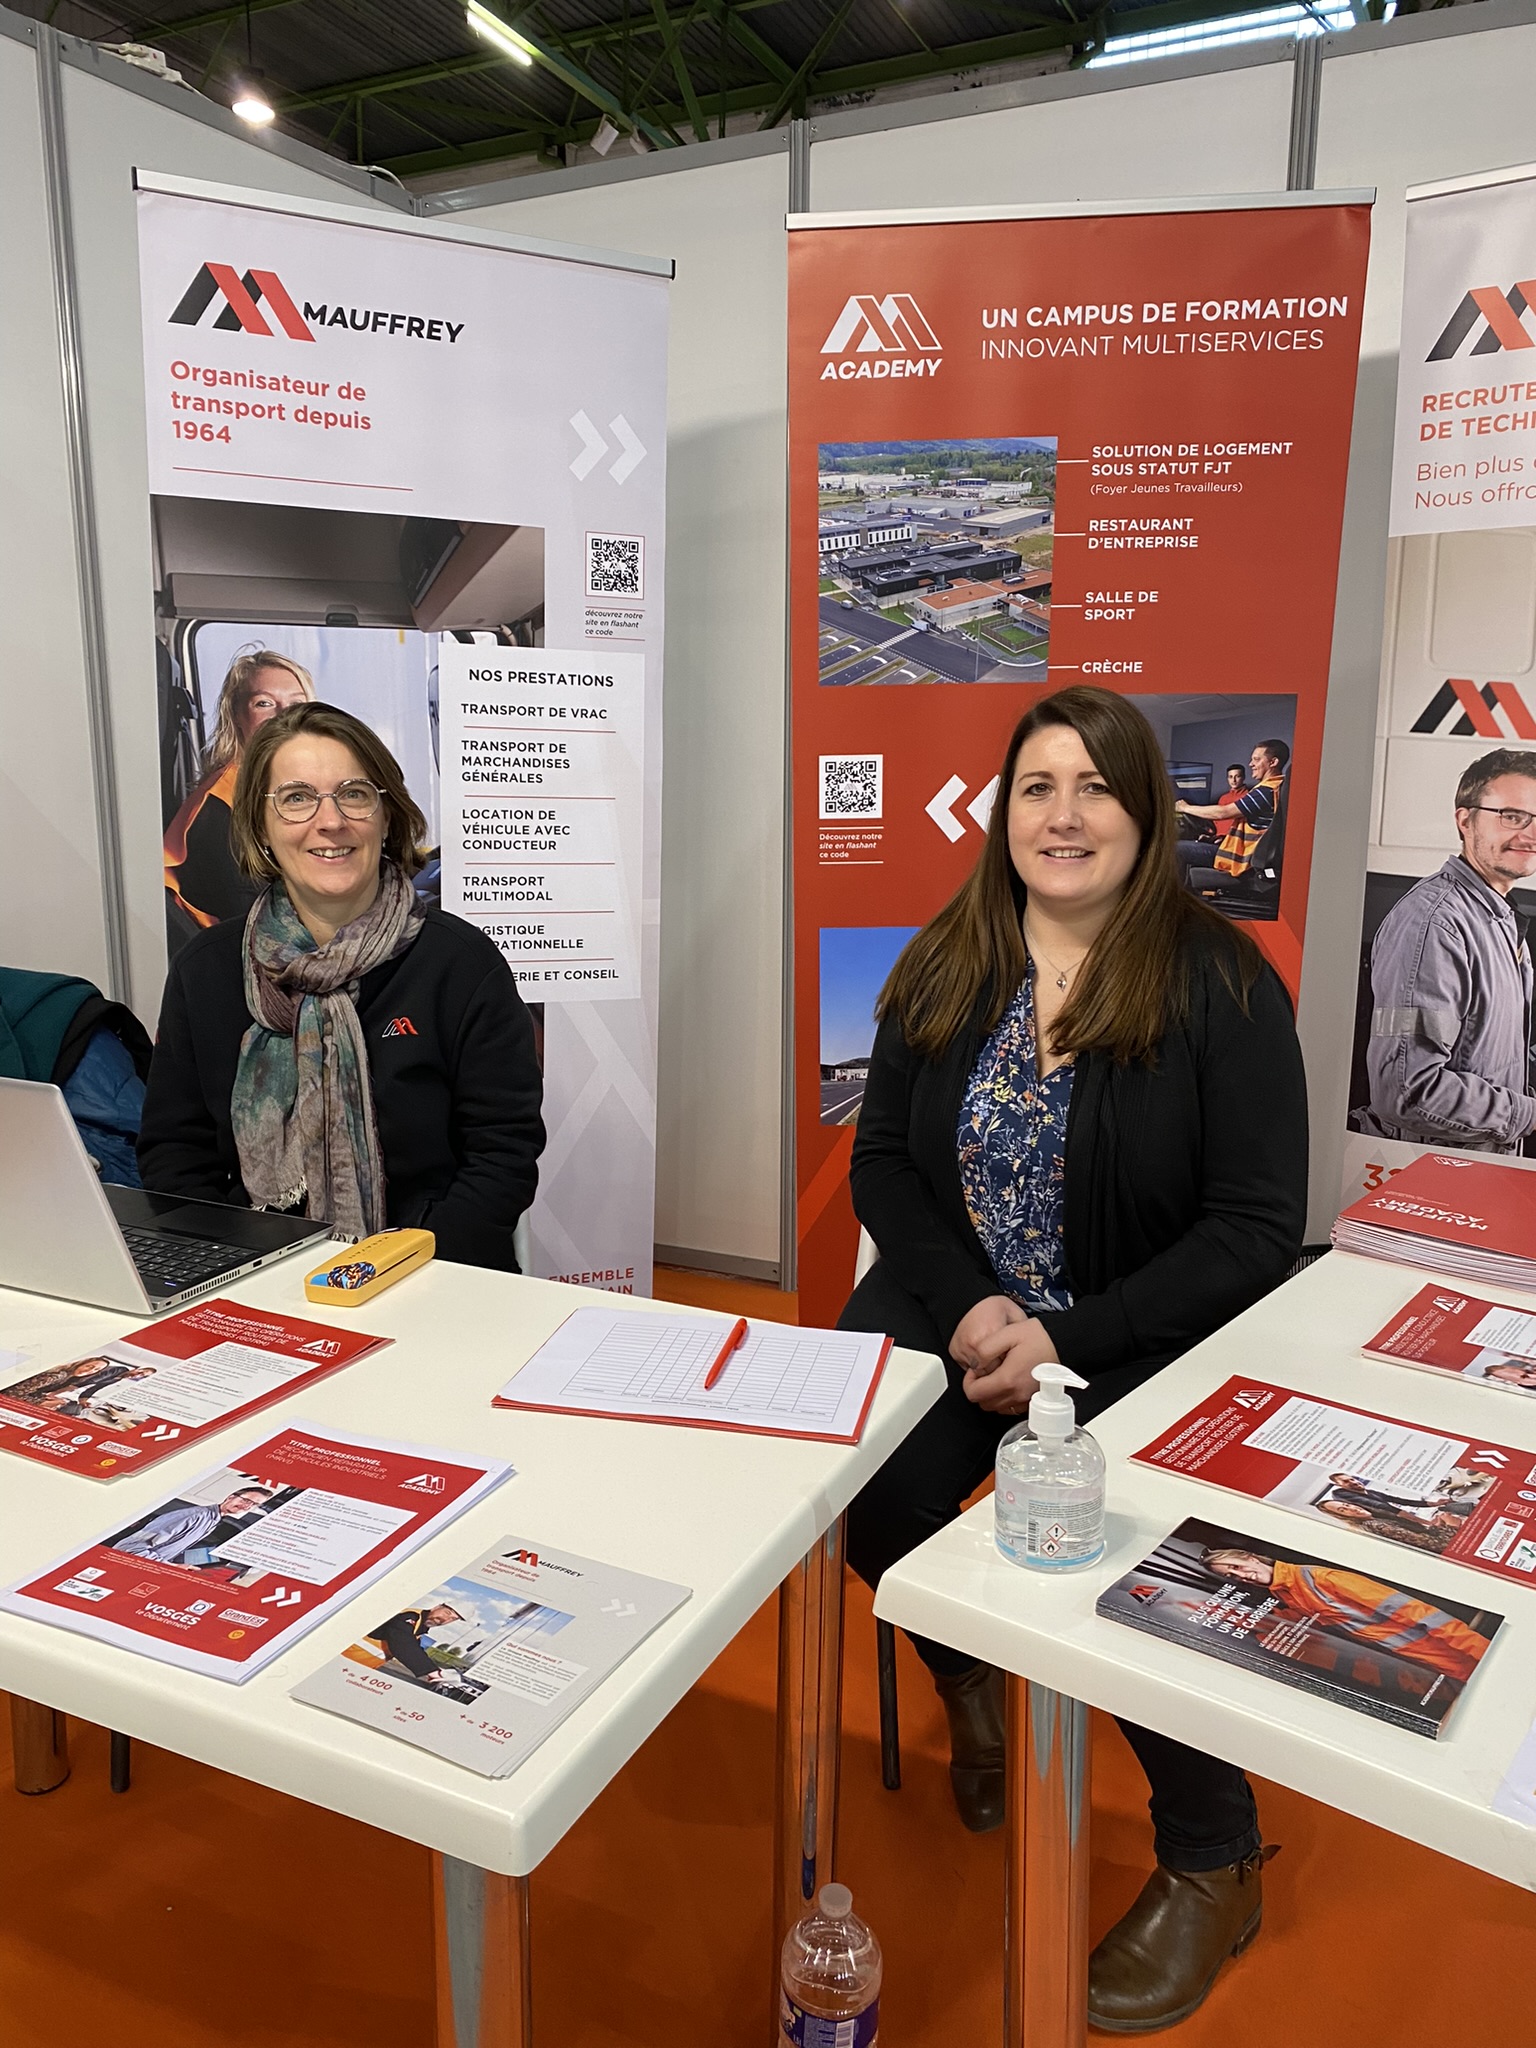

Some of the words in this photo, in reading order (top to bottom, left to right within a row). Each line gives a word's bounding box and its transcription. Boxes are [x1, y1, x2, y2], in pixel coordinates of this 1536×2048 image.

[982, 307, 1017, 329] UN
[1026, 304, 1134, 327] CAMPUS
[1142, 303, 1176, 324] DE
[1185, 296, 1348, 322] FORMATION
[303, 301, 465, 343] MAUFFREY
[982, 336, 1114, 360] INNOVANT
[1122, 329, 1324, 357] MULTISERVICES
[820, 358, 942, 380] ACADEMY
[170, 360, 330, 398] Organisateur
[337, 381, 367, 401] de
[171, 391, 286, 422] transport
[293, 404, 372, 432] depuis
[172, 421, 232, 444] 1964
[1420, 421, 1453, 442] DE
[1092, 444, 1173, 458] SOLUTION
[1178, 443, 1199, 457] DE
[1204, 442, 1293, 456] LOGEMENT
[1092, 462, 1132, 476] SOUS
[1138, 461, 1199, 475] STATUT
[1204, 461, 1232, 474] FJT
[1417, 463, 1466, 482] Bien
[1475, 455, 1524, 479] plus
[1090, 483, 1127, 497] (Foyer
[1131, 482, 1170, 495] Jeunes
[1174, 481, 1244, 495] Travailleurs)
[1415, 490, 1472, 509] Nous
[1089, 518, 1194, 532] RESTAURANT
[1088, 535, 1199, 550] D'ENTREPRISE
[1085, 591, 1134, 605] SALLE
[1139, 591, 1159, 604] DE
[585, 609, 622, 618] découvrez
[624, 611, 643, 619] notre
[1084, 607, 1135, 621] SPORT
[595, 628, 613, 636] code
[610, 620, 639, 628] flashant
[1081, 657, 1143, 674] CRÈCHE
[468, 669, 502, 682] NOS
[508, 671, 614, 687] PRESTATIONS
[461, 703, 544, 718] TRANSPORT
[549, 708, 566, 718] DE
[571, 708, 608, 719] VRAC
[461, 740, 545, 753] TRANSPORT
[549, 743, 567, 753] DE
[461, 756, 570, 769] MARCHANDISES
[461, 769, 543, 784] GÉNÉRALES
[462, 809, 534, 820] LOCATION
[538, 809, 556, 820] DE
[462, 822, 530, 835] VÉHICULE
[534, 825, 571, 836] AVEC
[462, 839, 557, 851] CONDUCTEUR
[463, 876, 545, 887] TRANSPORT
[463, 891, 553, 901] MULTIMODAL
[481, 925, 545, 936] GISTIQUE
[544, 971, 560, 981] ET
[564, 969, 619, 980] CONSEIL
[1368, 1202, 1488, 1231] MAUFFREY
[1373, 1197, 1484, 1222] ACADEMY
[204, 1308, 225, 1319] TITRE
[295, 1347, 335, 1359] ACADEMY
[1253, 1391, 1276, 1411] ACADEMY
[29, 1434, 79, 1454] VOSGES
[289, 1439, 312, 1451] TITRE
[313, 1444, 381, 1466] PROFESSIONNEL
[273, 1448, 288, 1457] DE
[332, 1463, 387, 1481] INDUSTRIELS
[397, 1483, 442, 1496] ACADEMY
[538, 1560, 584, 1578] MAUFFREY
[143, 1610, 191, 1631] Département
[144, 1601, 202, 1626] VOSGES
[1188, 1602, 1212, 1624] PLUS
[1216, 1619, 1234, 1634] UN
[1229, 1603, 1252, 1625] PLAN
[1231, 1625, 1250, 1640] DE
[1242, 1596, 1280, 1630] CARRIÈRE
[408, 1711, 425, 1722] 50
